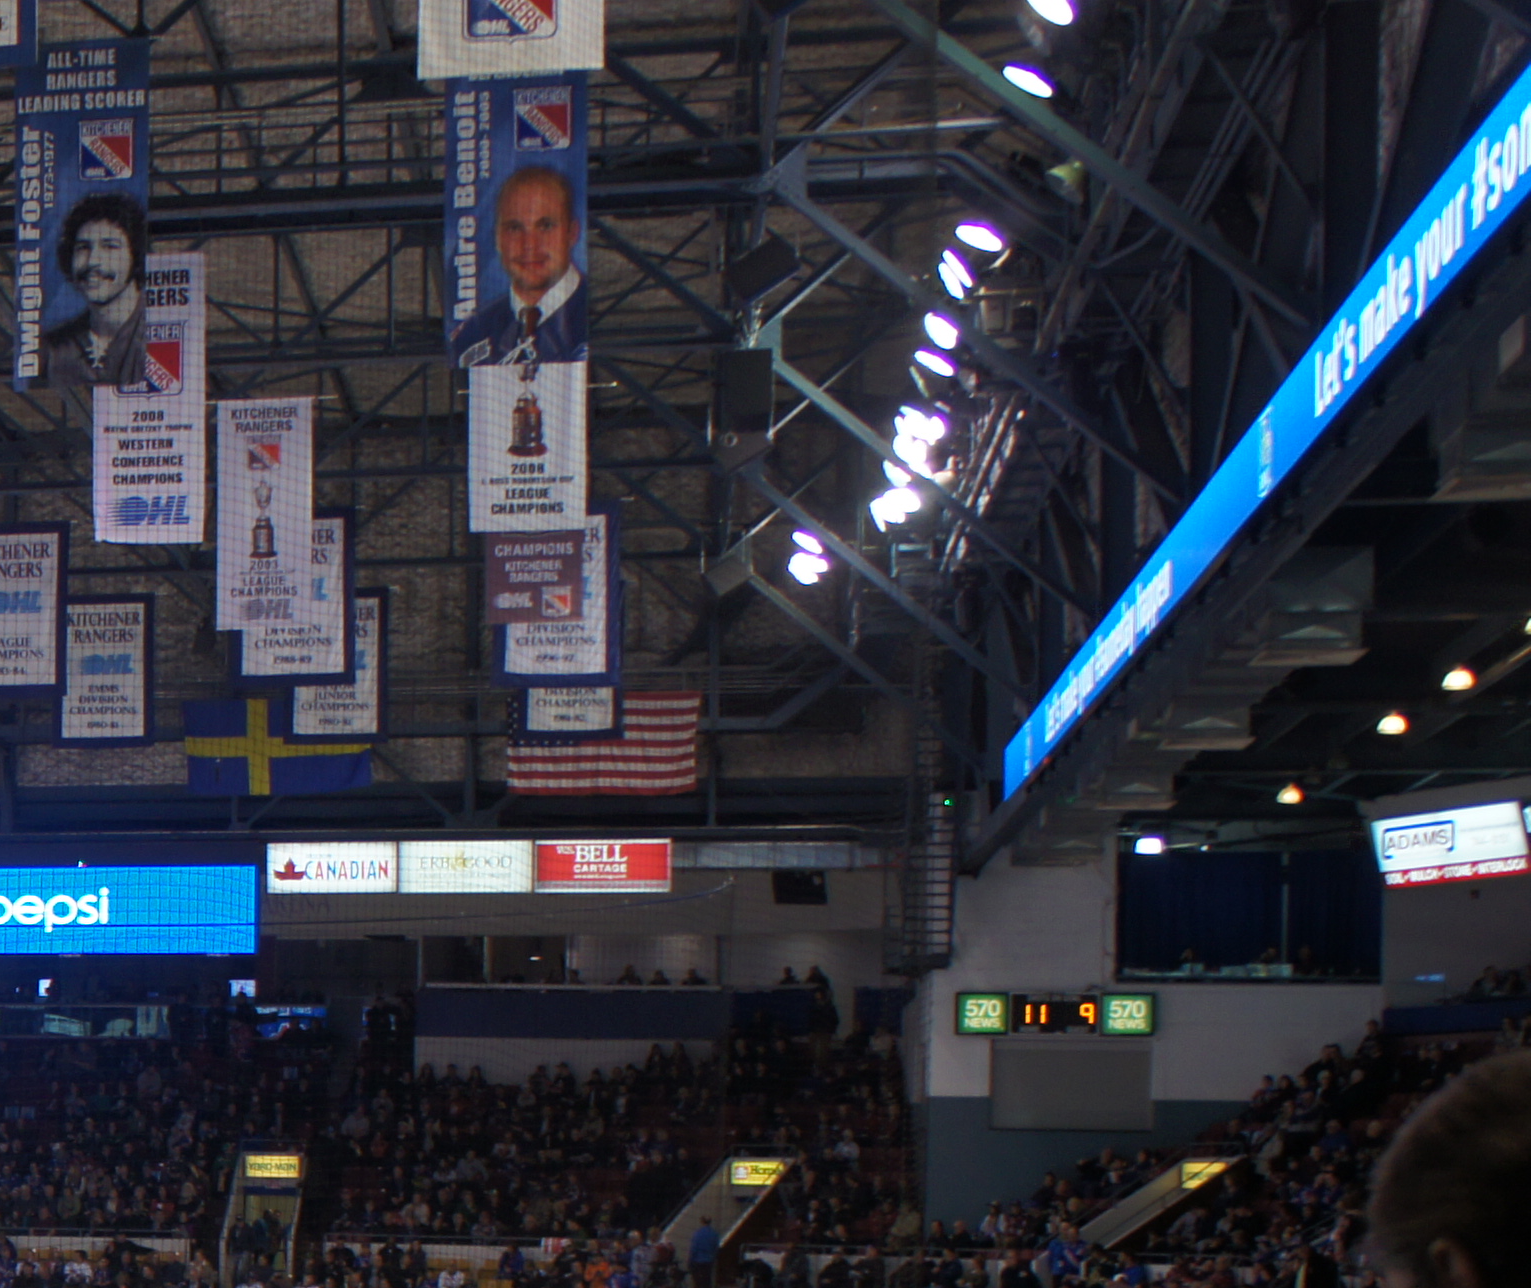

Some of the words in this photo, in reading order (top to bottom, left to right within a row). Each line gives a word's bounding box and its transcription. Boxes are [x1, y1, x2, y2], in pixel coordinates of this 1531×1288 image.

[46, 48, 117, 69] ALL-TIME
[46, 70, 117, 91] RANGERS
[18, 94, 81, 114] LEADING
[85, 90, 146, 109] SCORER
[453, 91, 477, 208] Benoit
[18, 125, 42, 241] Foster
[454, 214, 477, 320] Andre
[1315, 318, 1357, 418] Let's
[1359, 254, 1411, 364] make
[1415, 182, 1468, 319] your
[132, 411, 165, 422] 2008
[231, 407, 298, 420] KITCHENER
[235, 420, 293, 433] RANGERS
[118, 438, 174, 450] WESTERN
[112, 455, 184, 467] CONFERENCE
[113, 473, 183, 485] CHAMPIONS
[505, 488, 550, 500] LEAGUE
[107, 495, 189, 526] OHL
[491, 502, 564, 515] CHAMPIONS
[494, 543, 573, 557] CHAMPIONS
[504, 560, 562, 572] KITCHENER
[243, 576, 286, 587] LEAGUE
[230, 585, 298, 598] CHAMPIONS
[68, 611, 142, 627] KITCHENER
[74, 628, 134, 644] RANGERS
[255, 636, 333, 649] CHAMPIONS
[516, 635, 597, 646] CHAMPIONS
[1387, 829, 1449, 850] ADAMS
[575, 845, 628, 862] BELL
[466, 855, 512, 869] GOOD
[573, 863, 627, 873] CARTAGE
[304, 859, 388, 880] CANADIAN
[965, 1000, 1000, 1017] 570
[1025, 1004, 1049, 1024] 11
[1080, 1003, 1094, 1024] 9
[1109, 1001, 1145, 1018] 570
[964, 1017, 1001, 1028] NEWS
[1109, 1018, 1145, 1029] NEWS
